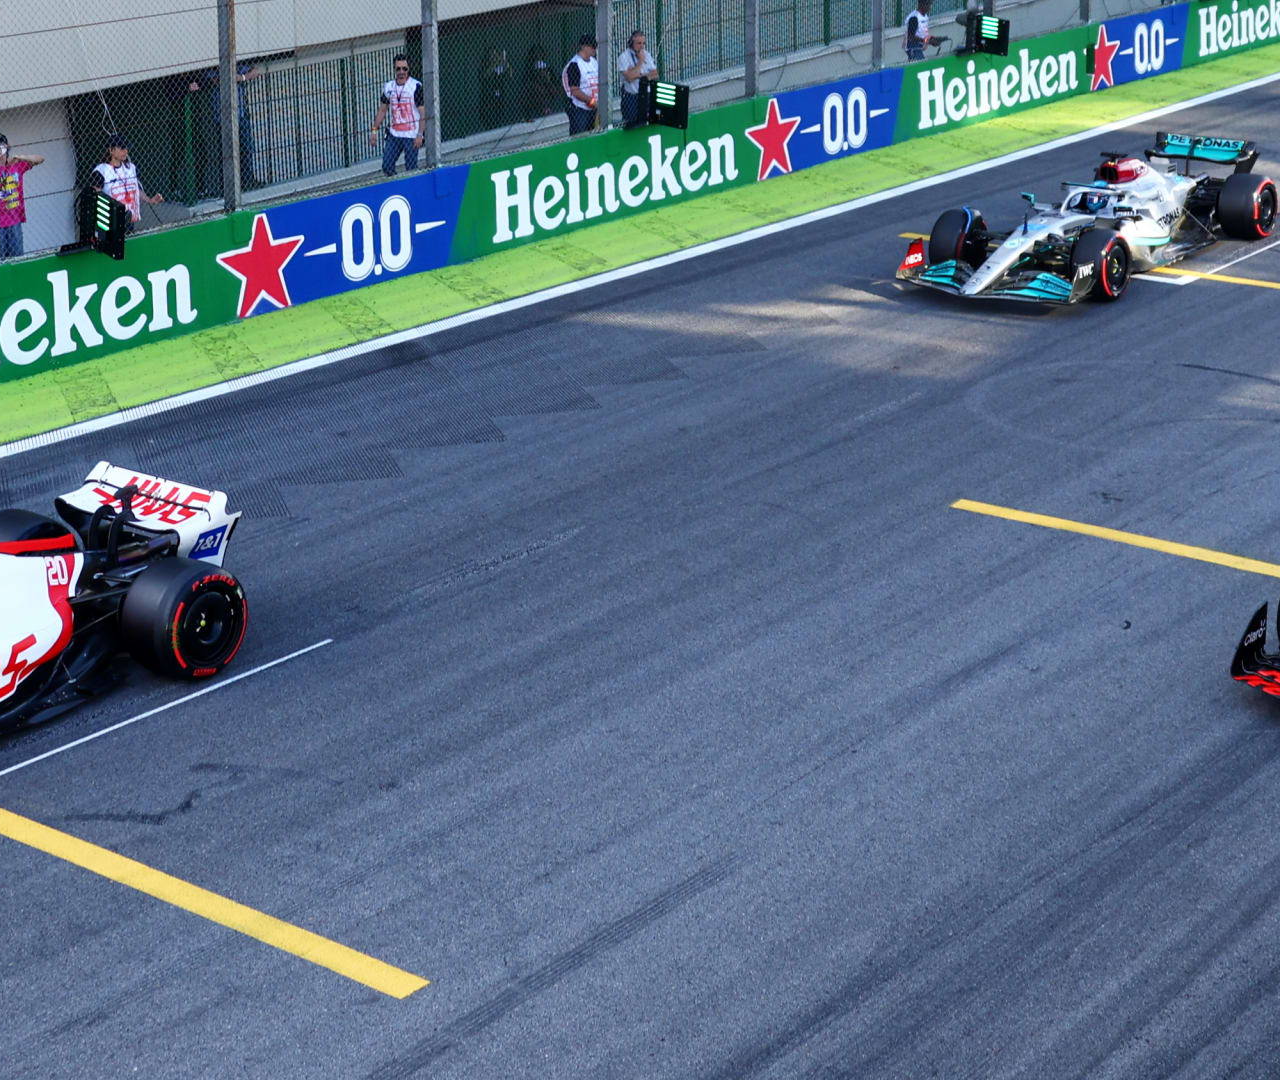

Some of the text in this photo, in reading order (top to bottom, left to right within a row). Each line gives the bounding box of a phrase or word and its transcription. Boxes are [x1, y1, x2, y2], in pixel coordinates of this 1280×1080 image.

[917, 18, 1166, 130] Heineken 0.0
[489, 85, 869, 245] Heineken 0.0
[339, 194, 413, 282] 0.0
[45, 556, 69, 587] 20
[195, 531, 224, 553] 1&1
